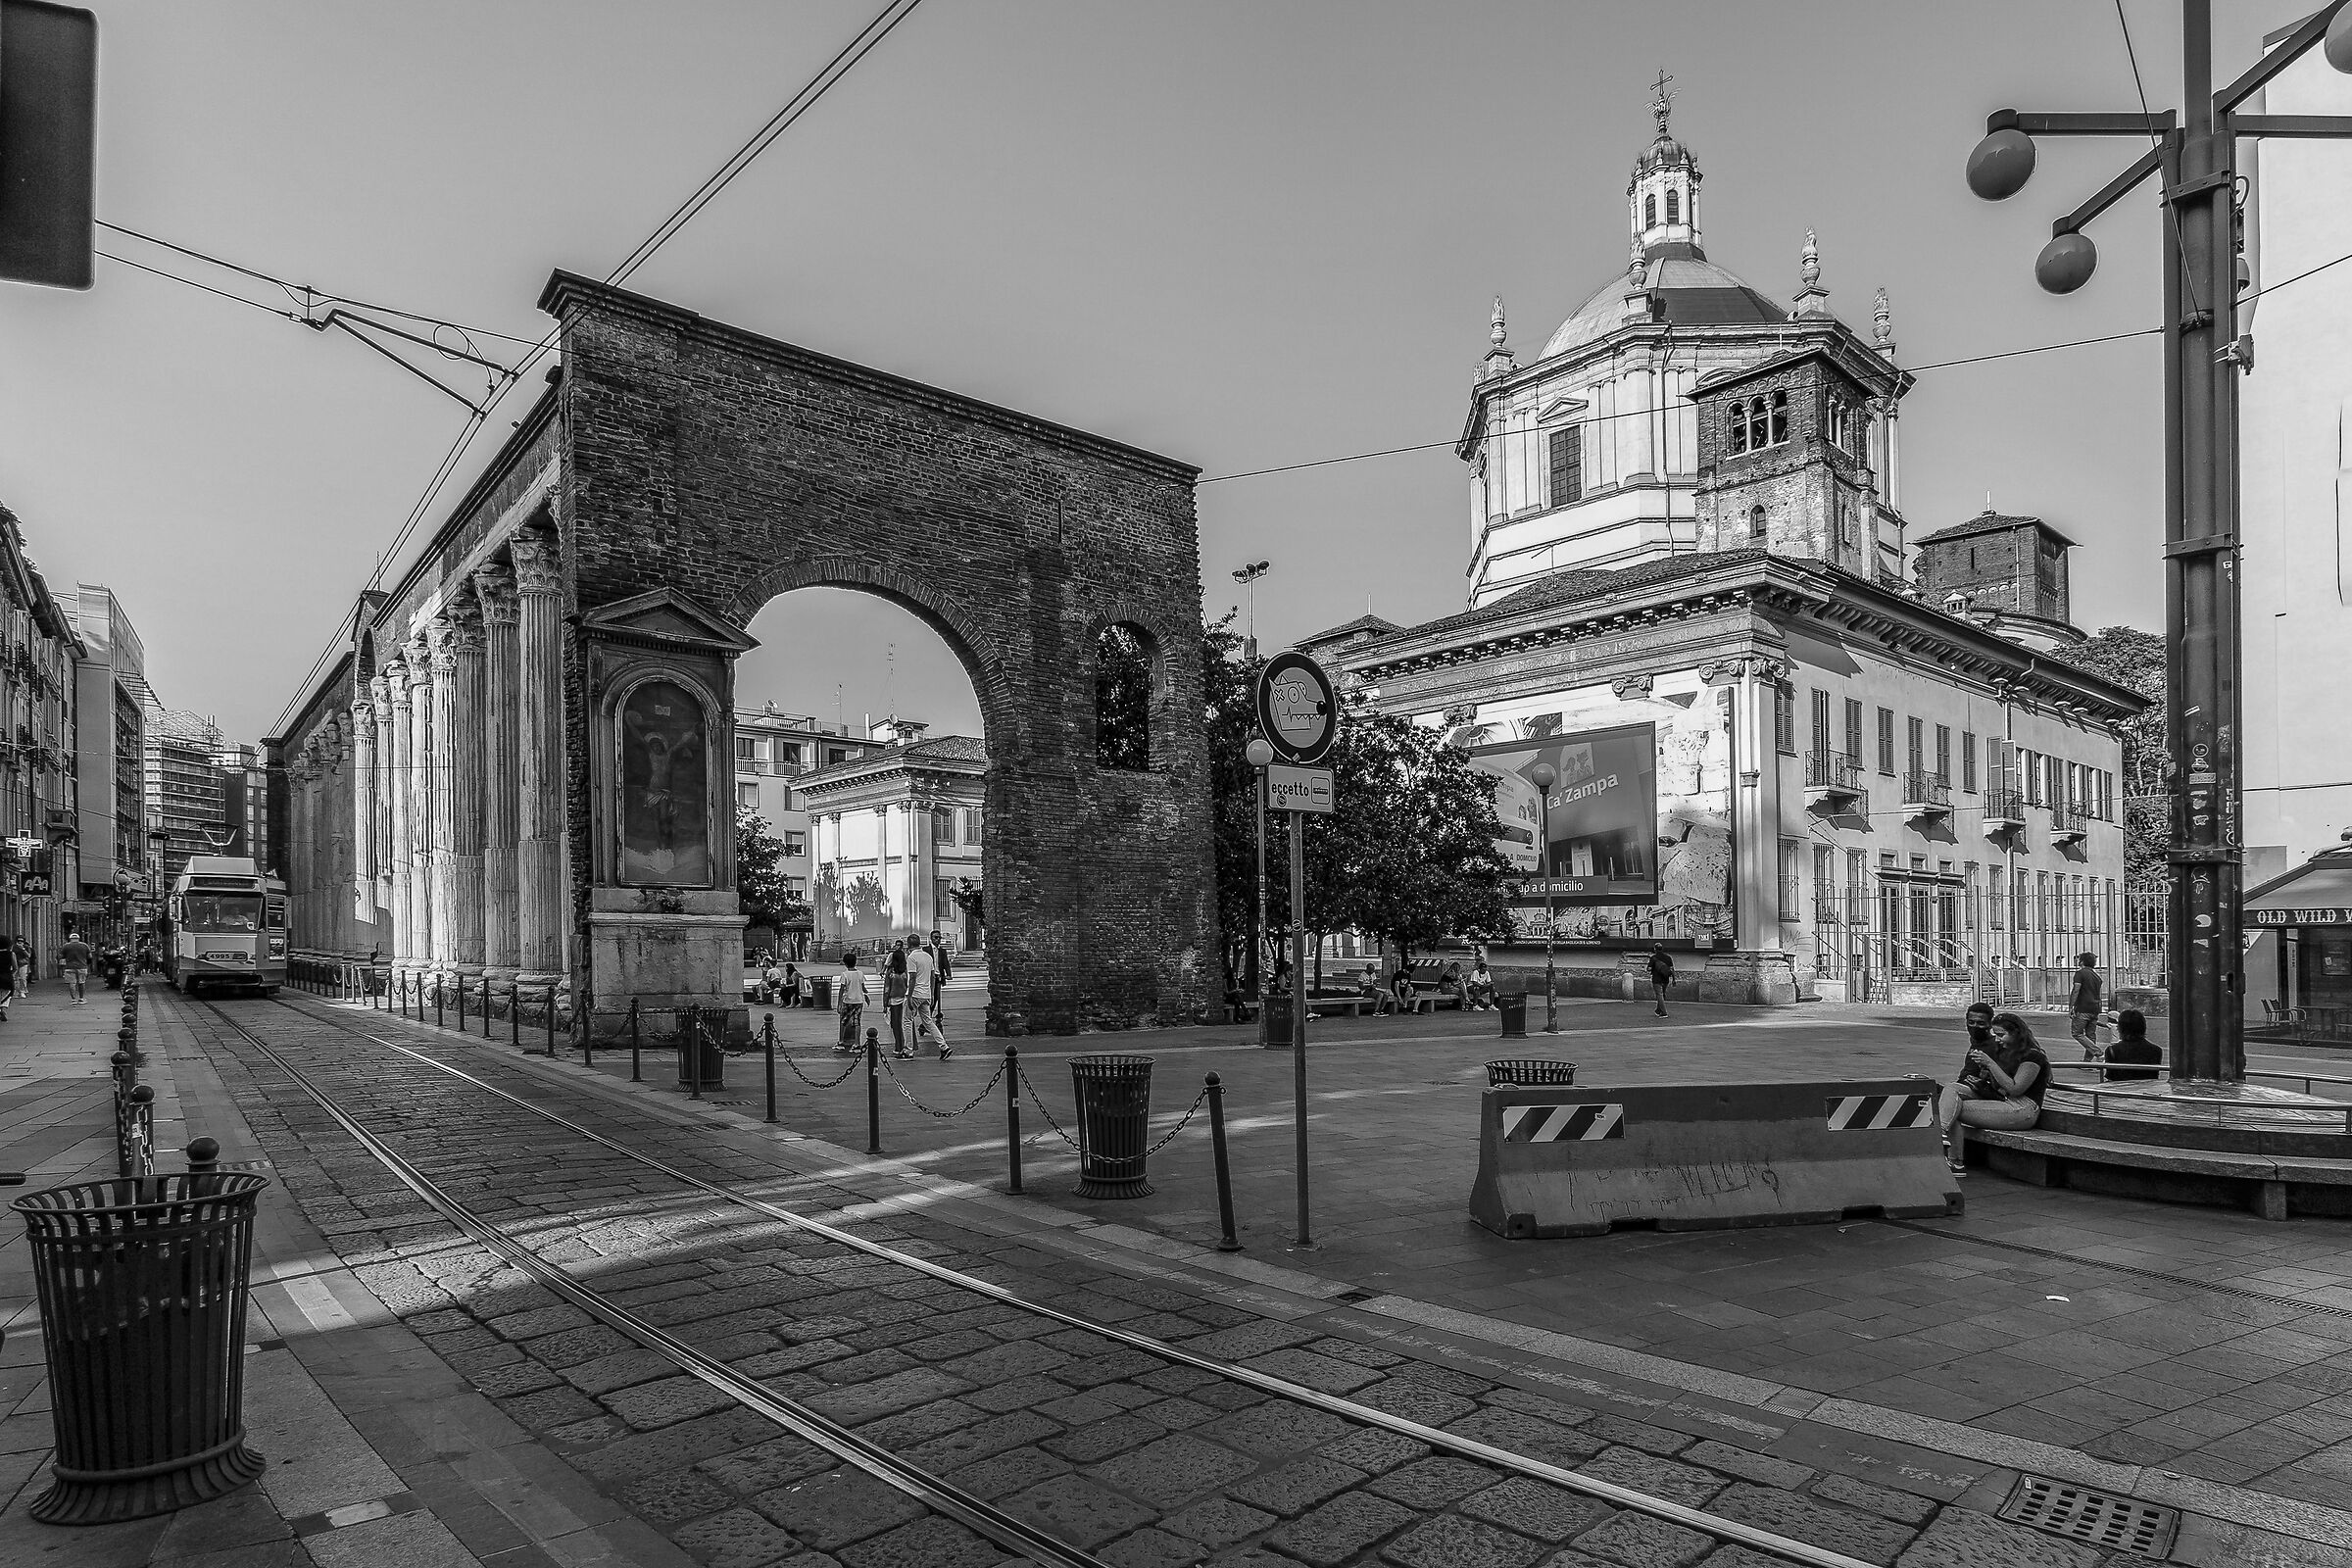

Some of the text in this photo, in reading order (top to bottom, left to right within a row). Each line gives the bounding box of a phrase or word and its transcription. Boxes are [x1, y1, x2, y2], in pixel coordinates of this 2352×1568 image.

[1271, 781, 1309, 797] eccetto
[1565, 773, 1619, 804] Zampa
[1532, 884, 1539, 893] a
[2257, 910, 2287, 924] OLD
[2293, 909, 2337, 923] WILD
